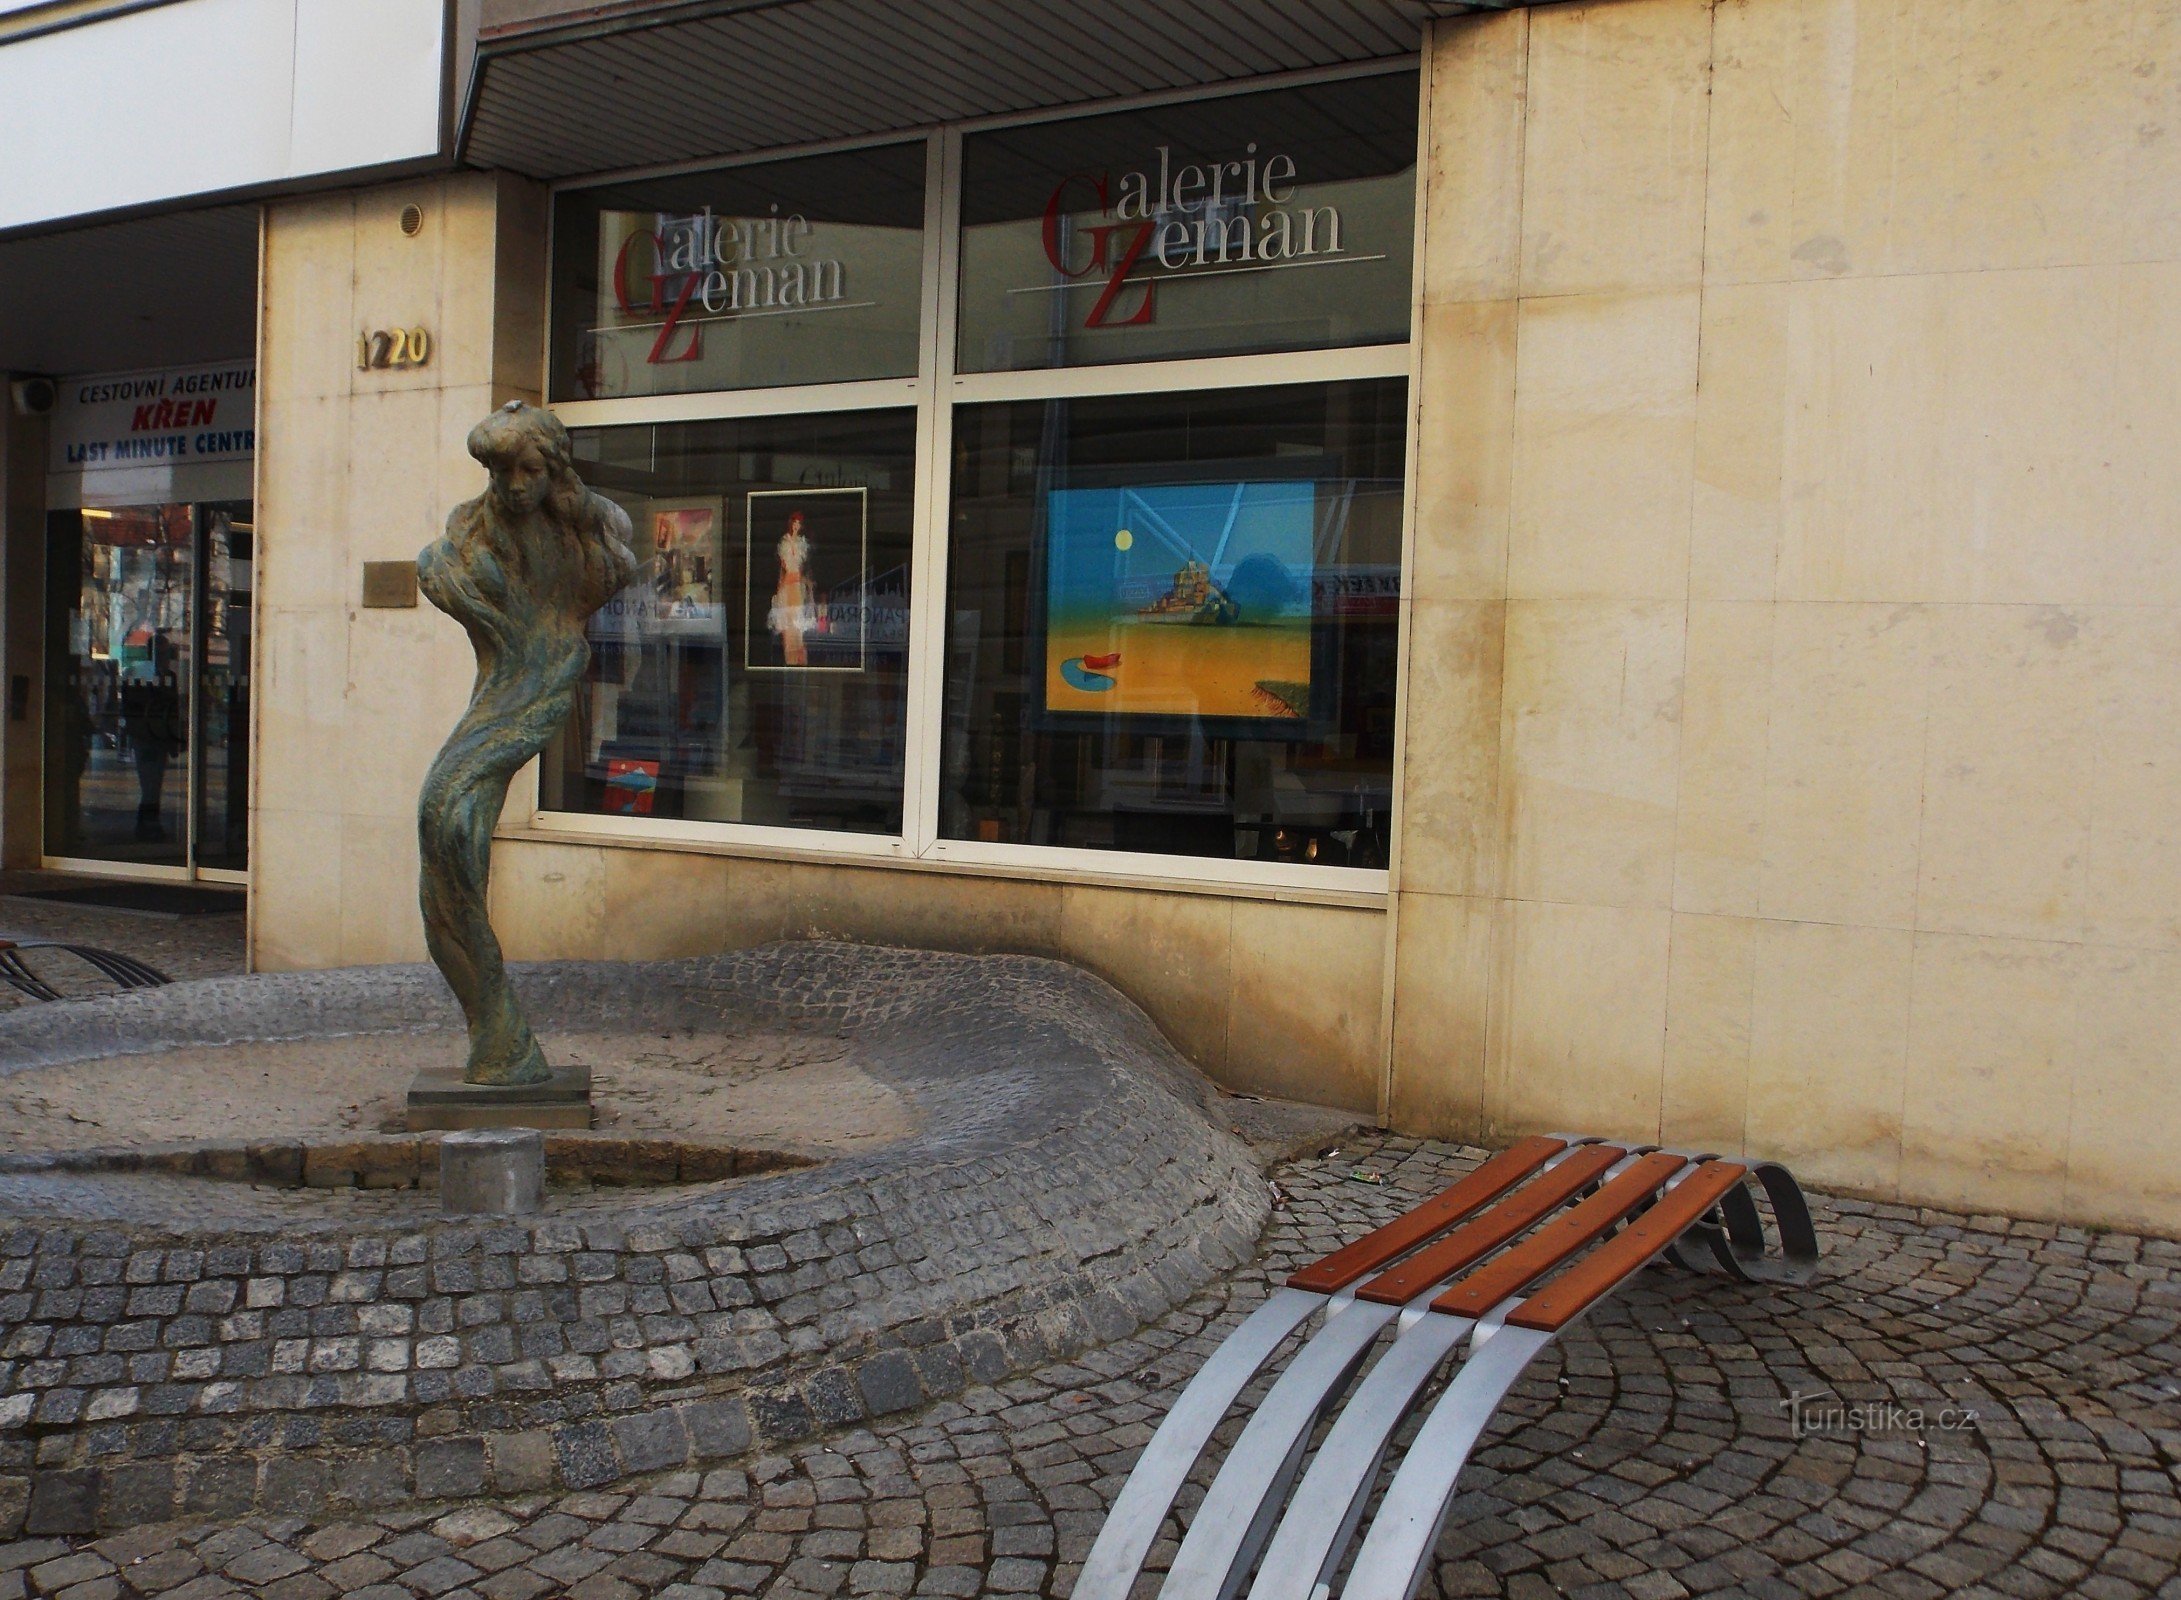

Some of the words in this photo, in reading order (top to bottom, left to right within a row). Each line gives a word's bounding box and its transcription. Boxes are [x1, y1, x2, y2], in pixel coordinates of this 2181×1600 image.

[1042, 143, 1296, 277] Galerie
[613, 203, 811, 319] Galerie
[1084, 206, 1344, 328] Zeman
[355, 326, 428, 369] 1220
[646, 258, 843, 365] Zeman
[79, 374, 165, 404] CESTOVNÍ
[131, 397, 217, 431] KŘEN
[67, 440, 109, 463] LAST
[115, 435, 187, 459] MINUTE
